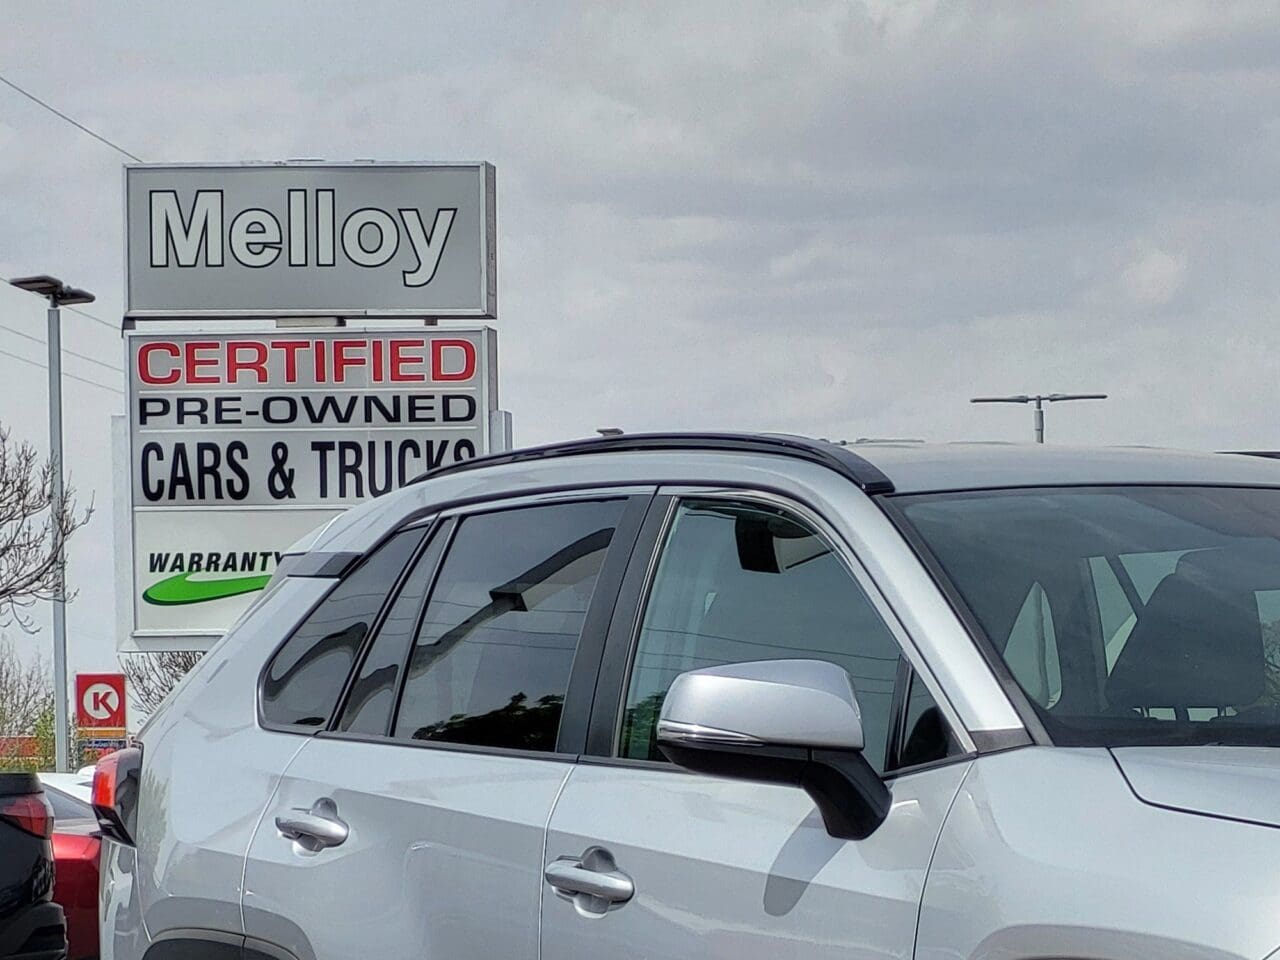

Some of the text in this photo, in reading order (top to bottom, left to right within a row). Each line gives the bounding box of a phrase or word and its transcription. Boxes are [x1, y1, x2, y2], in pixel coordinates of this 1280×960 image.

[148, 188, 457, 287] Melloy
[136, 339, 477, 384] CERTIFIED
[139, 394, 477, 425] PRE-OWNED
[141, 441, 249, 500] CARS
[268, 441, 296, 499] &
